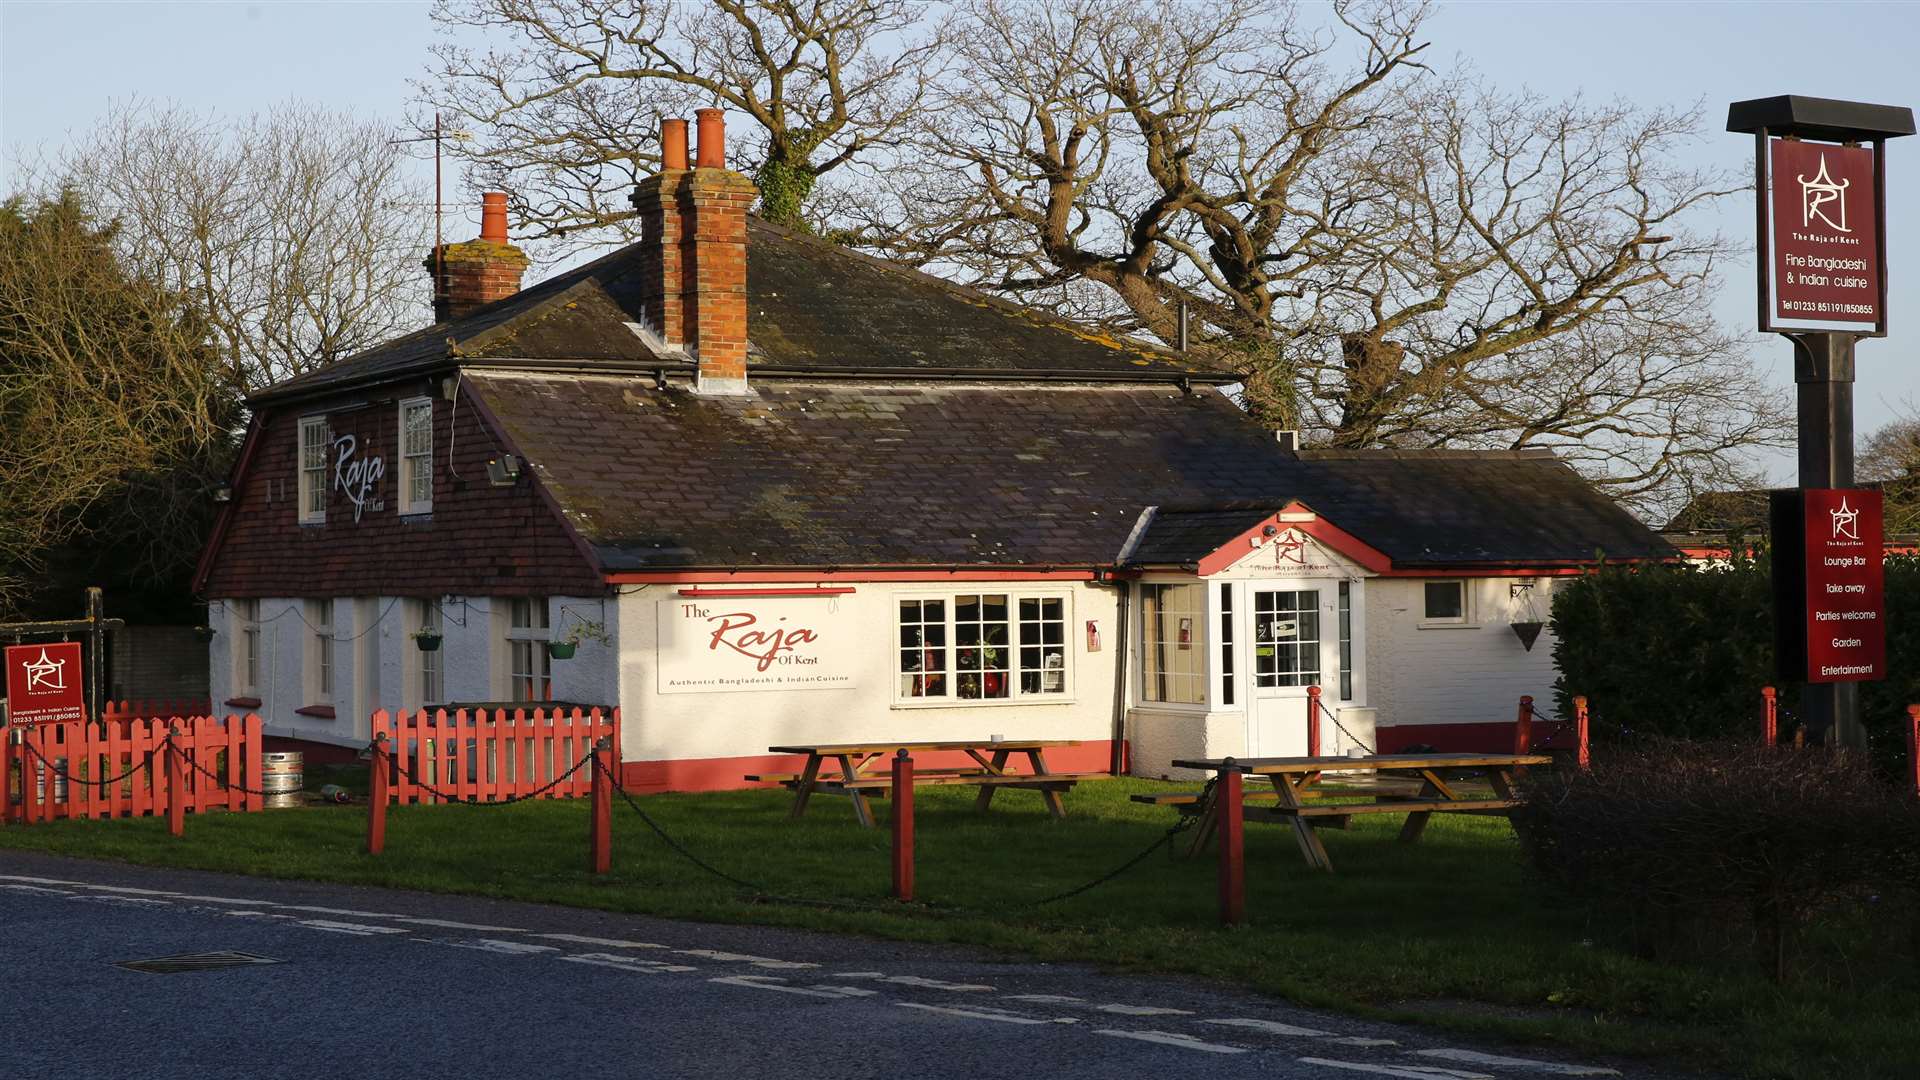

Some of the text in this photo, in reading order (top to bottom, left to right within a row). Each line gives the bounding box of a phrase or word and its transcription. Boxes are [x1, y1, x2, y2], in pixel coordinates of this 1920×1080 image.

[1792, 232, 1860, 245] The Raja of Kent
[1785, 253, 1867, 272] Fine Bangladeshi
[1786, 271, 1868, 289] & Indian cuisine
[1783, 300, 1874, 314] Tel 01233 851191/850855
[334, 434, 385, 524] Raja
[1824, 555, 1866, 568] Lounge Bar
[1826, 583, 1866, 595] Take away
[681, 603, 710, 618] The
[1815, 610, 1876, 621] Parties welcome
[707, 612, 818, 672] Raja
[1832, 637, 1862, 648] Garden
[778, 654, 818, 665] Of Kent
[1821, 663, 1873, 676] Entertainment
[669, 678, 716, 687] Authentic
[718, 677, 774, 686] Bangladeshi
[786, 675, 815, 683] Indian
[816, 674, 849, 683] Cuisine
[13, 716, 33, 724] 01233
